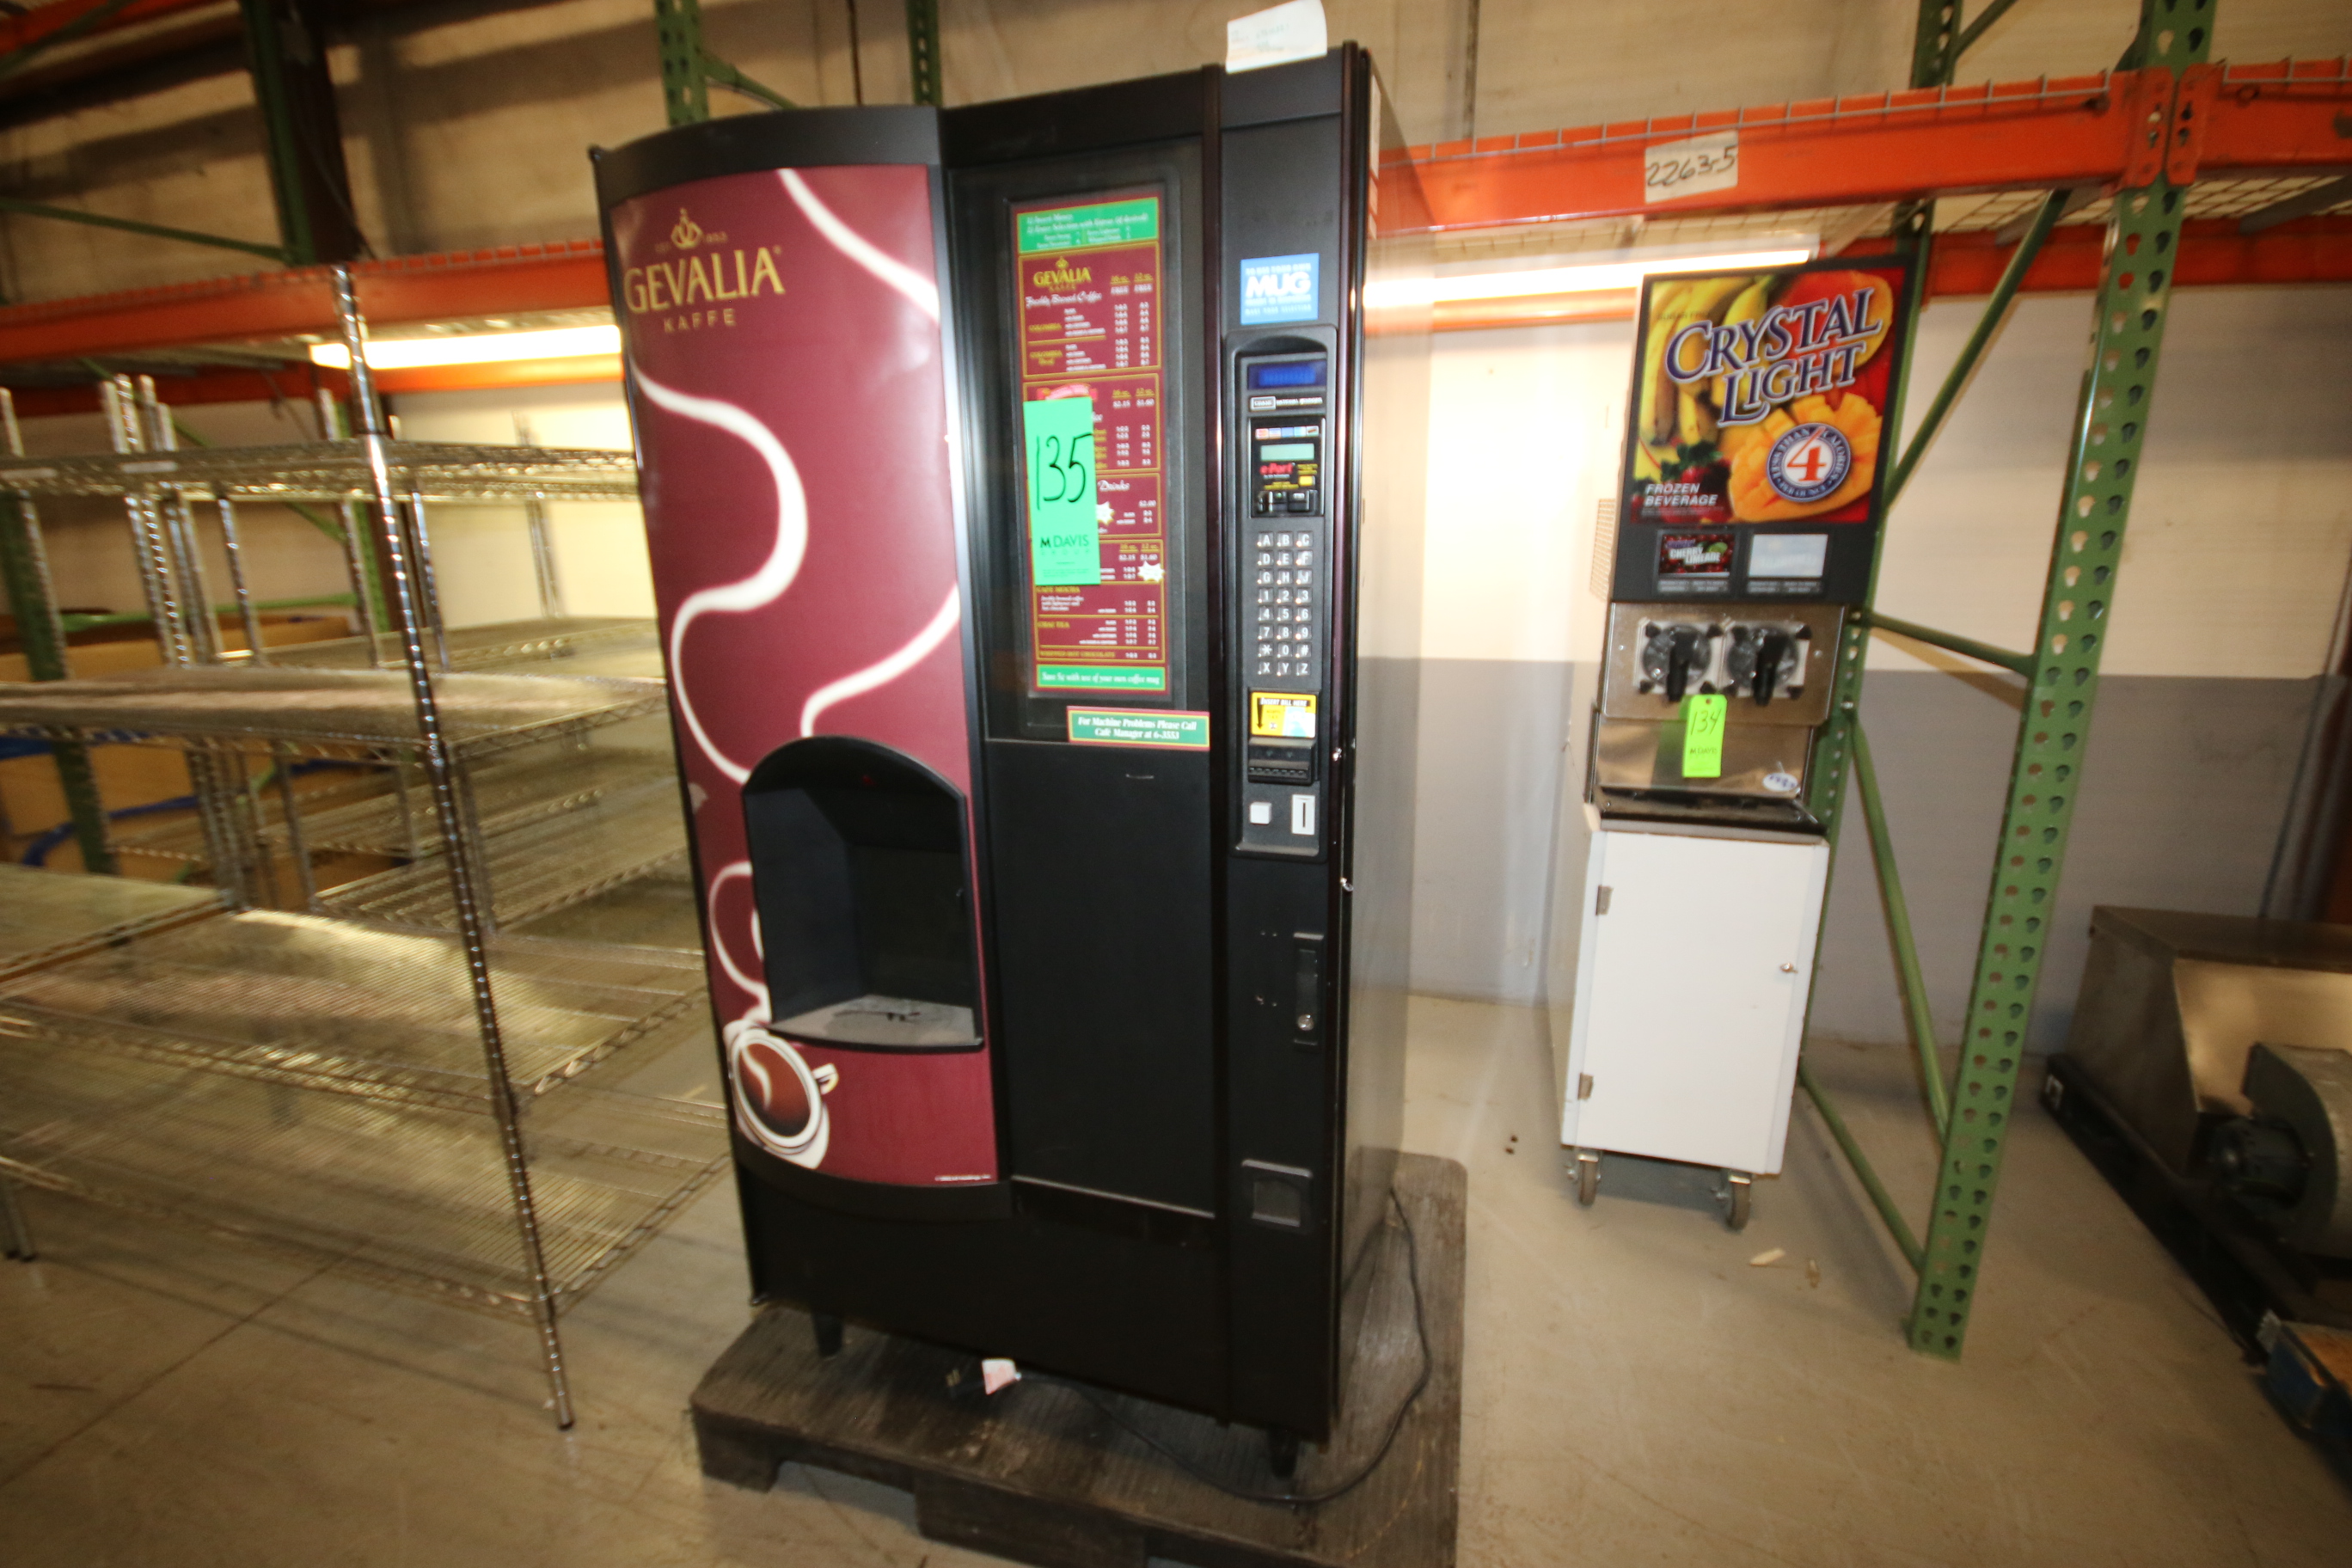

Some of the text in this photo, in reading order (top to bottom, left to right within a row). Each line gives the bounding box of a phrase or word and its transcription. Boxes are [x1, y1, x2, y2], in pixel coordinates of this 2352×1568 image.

[1645, 144, 1737, 187] 2263-5
[623, 247, 786, 314] GEVALIA
[1033, 267, 1092, 287] GEVALIA
[1246, 271, 1312, 298] MUG
[1076, 291, 1102, 303] Coffee
[663, 308, 737, 334] KAFFE
[1665, 287, 1882, 383] CRYSTAL
[1717, 341, 1866, 428] LIGHT
[1786, 426, 1826, 481] 4
[1037, 432, 1093, 511] 135
[1097, 480, 1130, 491] Drinks
[1645, 482, 1700, 494] FROZEN
[1644, 494, 1718, 506] BEVERAGE
[1263, 534, 1309, 544] A B C
[1263, 553, 1309, 563] D E F
[1669, 547, 1704, 560] CHERRY
[1683, 552, 1722, 565] LIMEADE
[1263, 572, 1271, 582] G
[1283, 572, 1289, 582] H
[1264, 590, 1309, 600] 1 2 3
[1263, 609, 1308, 619] 4 5 6
[1264, 627, 1308, 637] 7 8 9
[1283, 645, 1289, 654] 0
[1264, 663, 1308, 673] X Y Z
[1066, 672, 1081, 682] with
[1099, 675, 1113, 683] your
[1127, 674, 1146, 684] coffee
[1146, 676, 1160, 685] mug
[1077, 716, 1197, 731] For Machine Problems Please Call
[1691, 707, 1722, 735] 134
[1113, 728, 1144, 739] Manager
